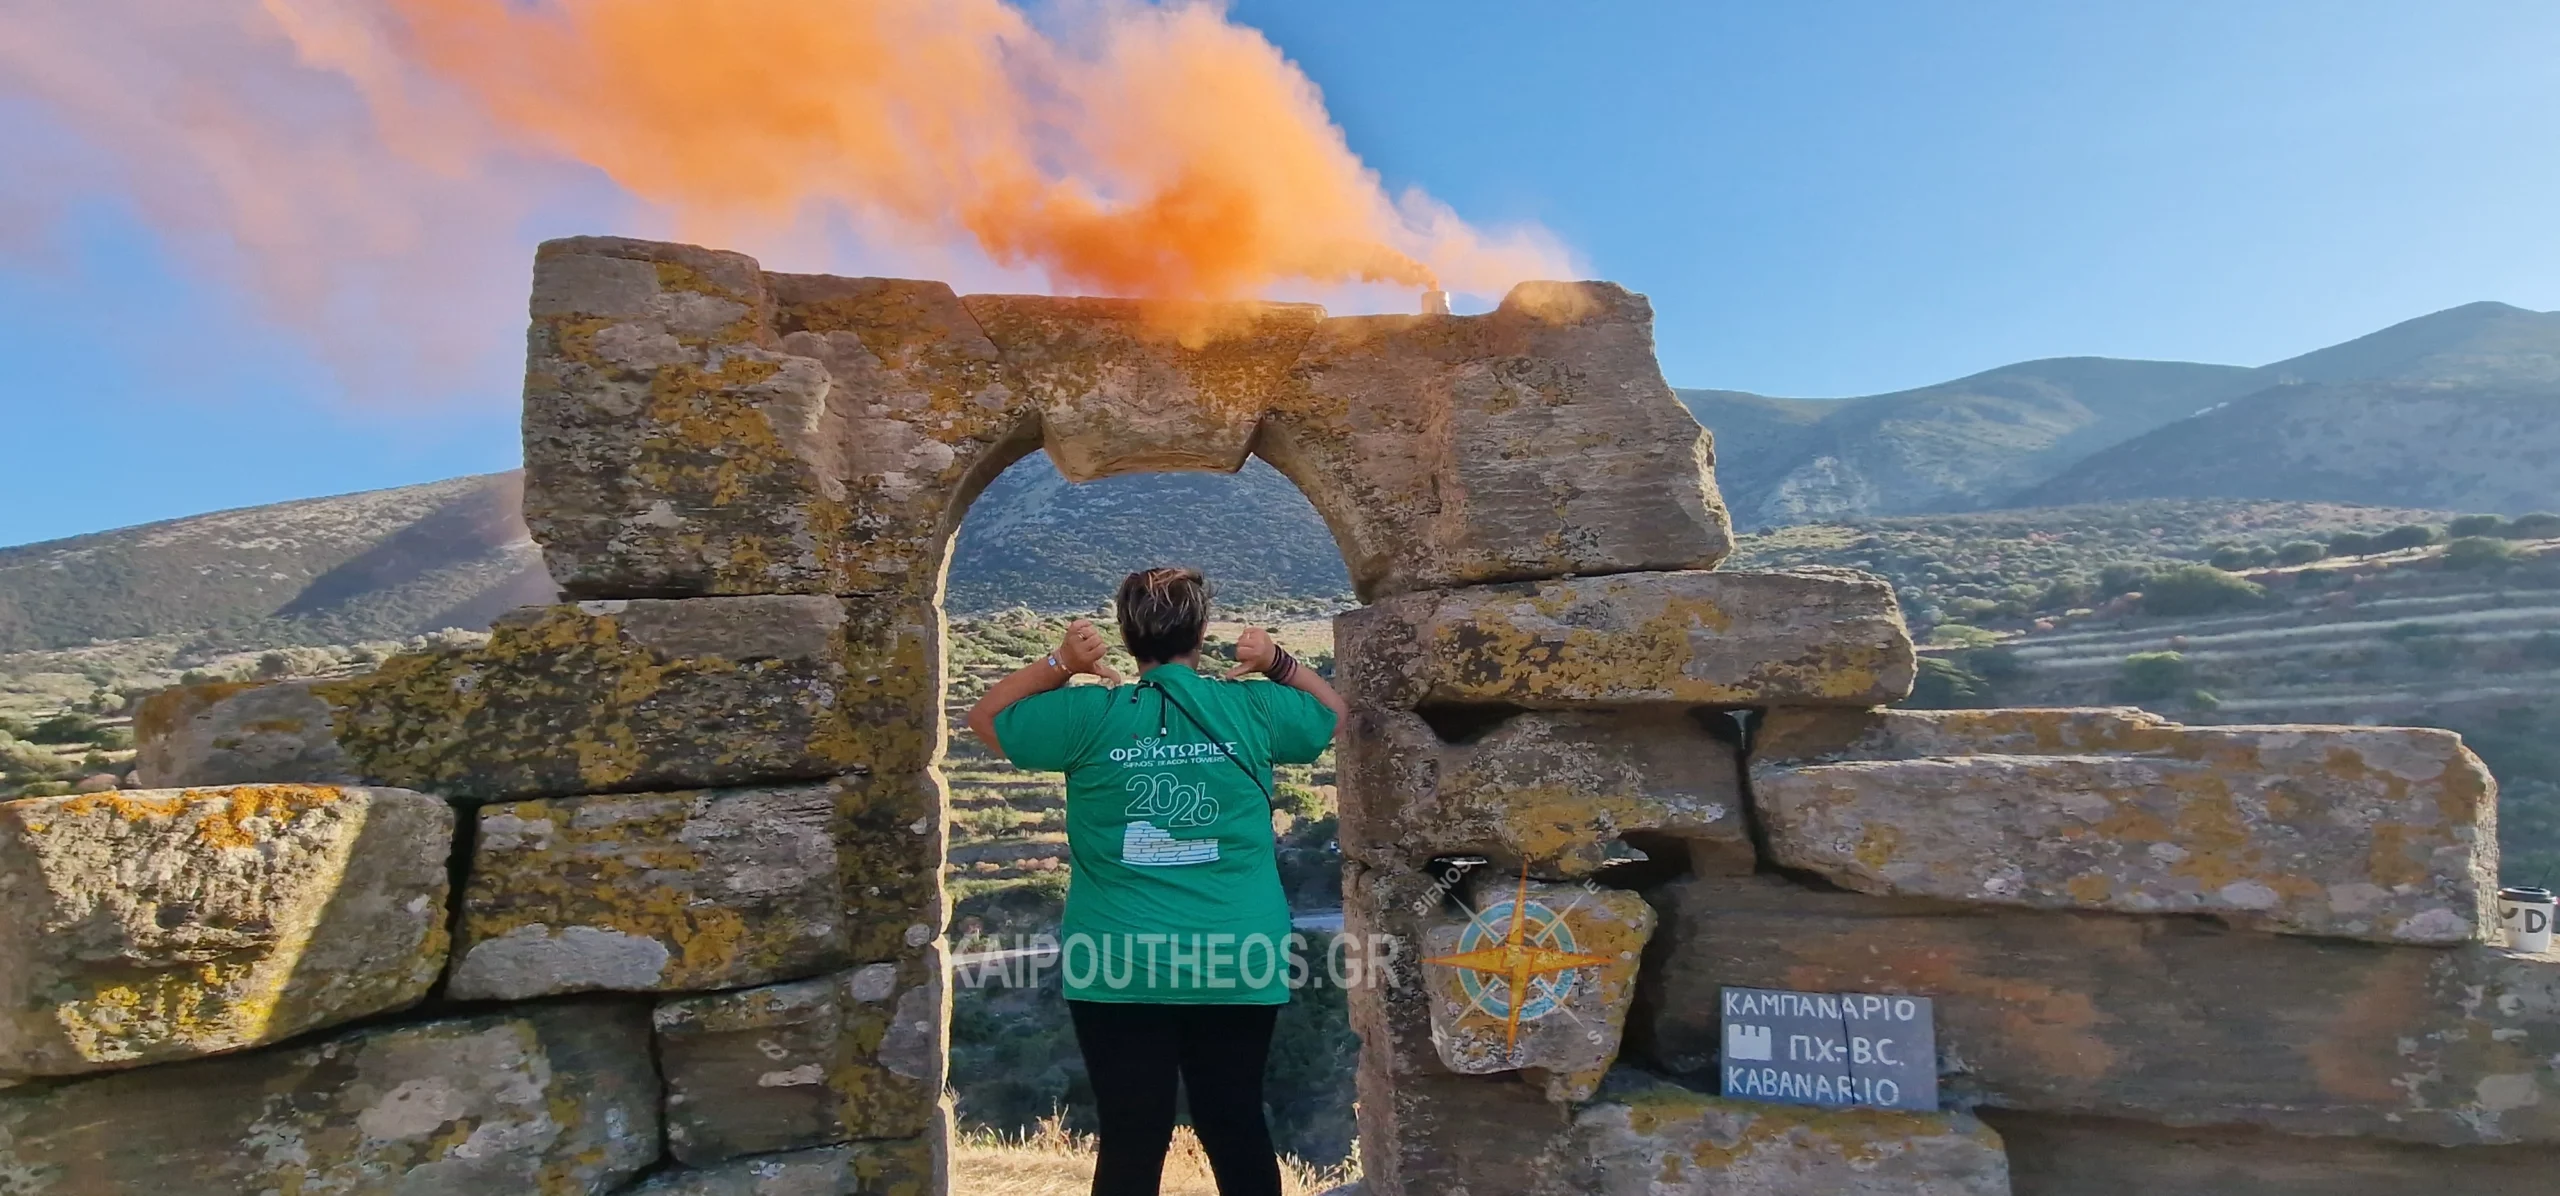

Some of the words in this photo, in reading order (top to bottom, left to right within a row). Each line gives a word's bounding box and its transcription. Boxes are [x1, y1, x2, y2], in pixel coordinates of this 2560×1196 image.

[1125, 772, 1220, 828] 2026
[1725, 991, 1916, 1022] ΚΑΜΠΑΝΑΡΙΟ
[1727, 1065, 1900, 1107] KABANARIO
